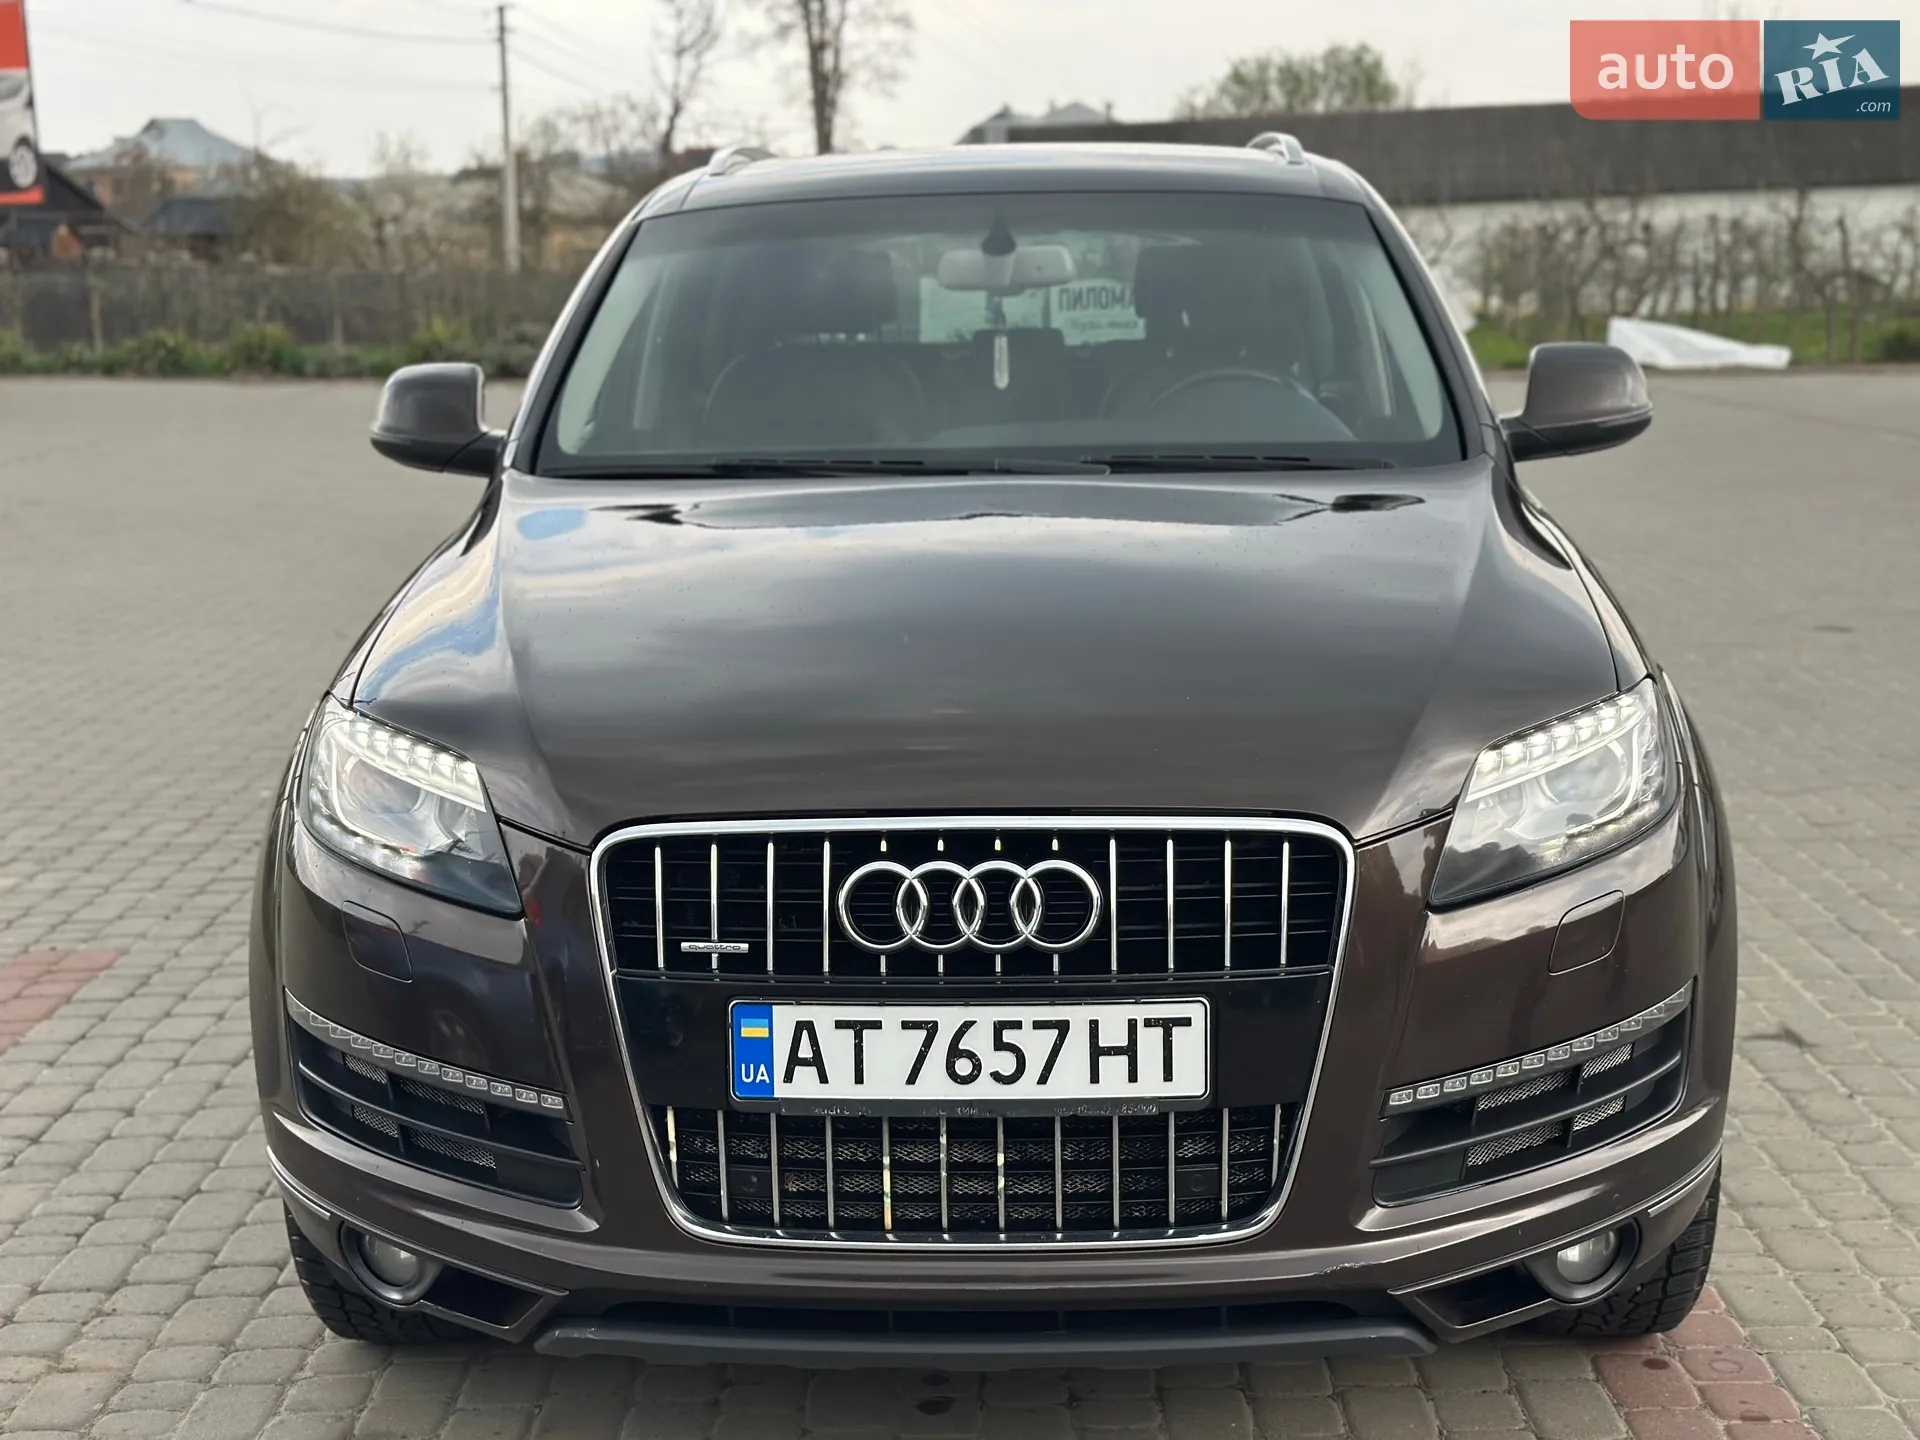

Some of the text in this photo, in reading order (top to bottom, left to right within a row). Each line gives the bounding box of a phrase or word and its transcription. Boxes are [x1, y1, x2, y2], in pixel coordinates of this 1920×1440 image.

[782, 1016, 1193, 1085] AT 7657 HT
[740, 1063, 770, 1084] UA
